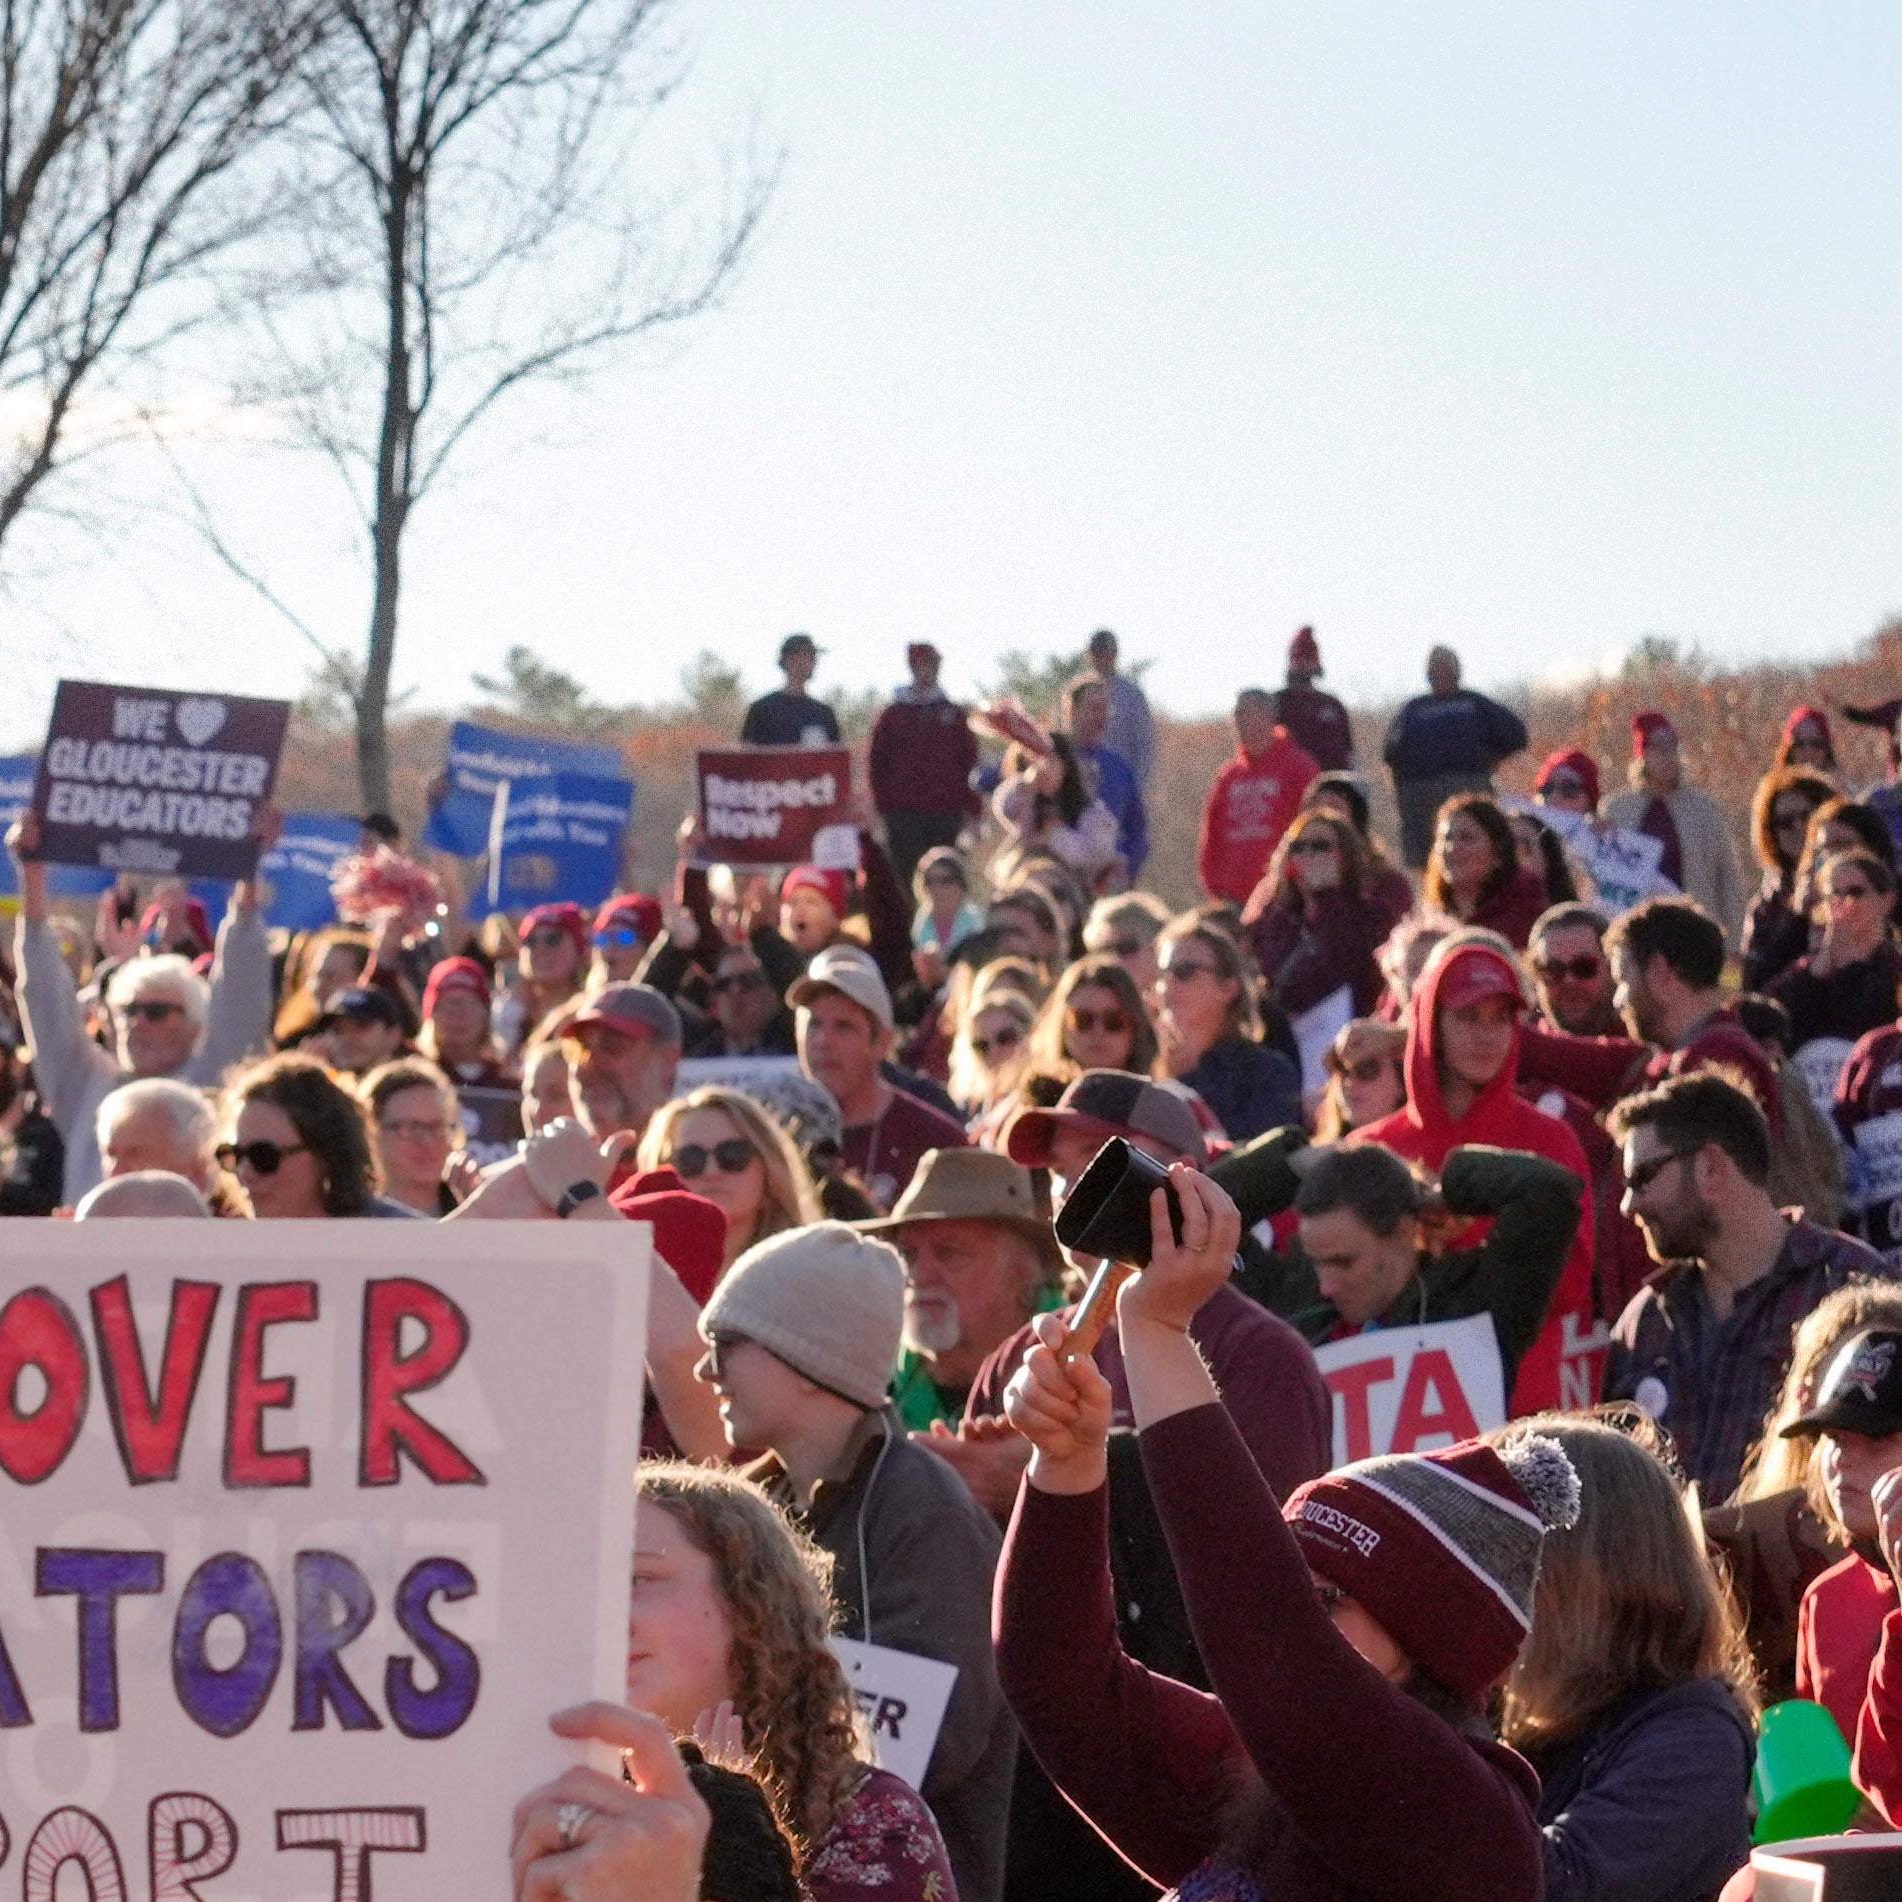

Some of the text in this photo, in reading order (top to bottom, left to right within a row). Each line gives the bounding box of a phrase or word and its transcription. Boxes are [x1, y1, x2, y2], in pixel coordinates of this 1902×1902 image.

[114, 698, 172, 741] WE
[47, 737, 270, 796] GLOUCESTER
[47, 781, 252, 841] EDUCATORS
[705, 772, 838, 812] Respect
[706, 808, 783, 841] Now
